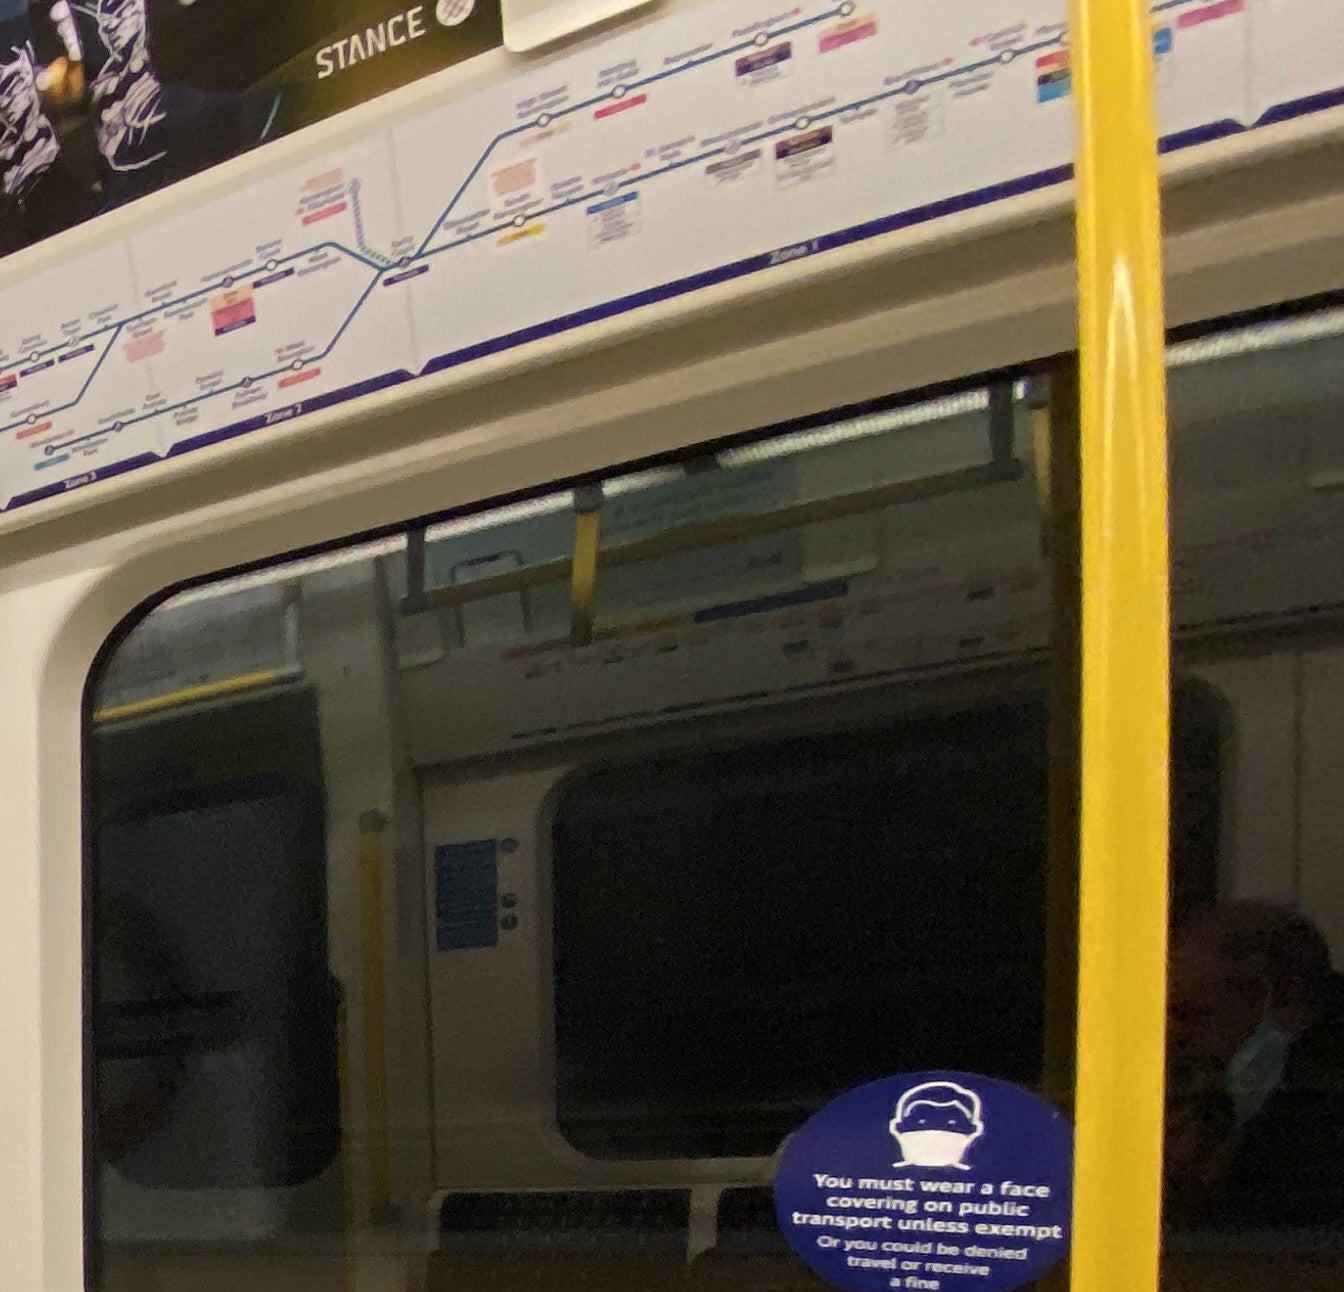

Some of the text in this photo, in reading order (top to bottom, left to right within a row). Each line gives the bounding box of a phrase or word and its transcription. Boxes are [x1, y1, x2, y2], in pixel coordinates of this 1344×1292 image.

[315, 5, 426, 80] STANCE
[265, 407, 293, 424] Zone
[64, 470, 97, 489] Zone 3
[813, 1173, 1051, 1198] You must wear a face
[826, 1195, 1031, 1217] covering on public
[792, 1211, 1064, 1241] transport unless exempt
[816, 1235, 1029, 1261] Or you could be denied
[846, 1255, 991, 1277] travel or receive
[889, 1275, 940, 1290] a fine
